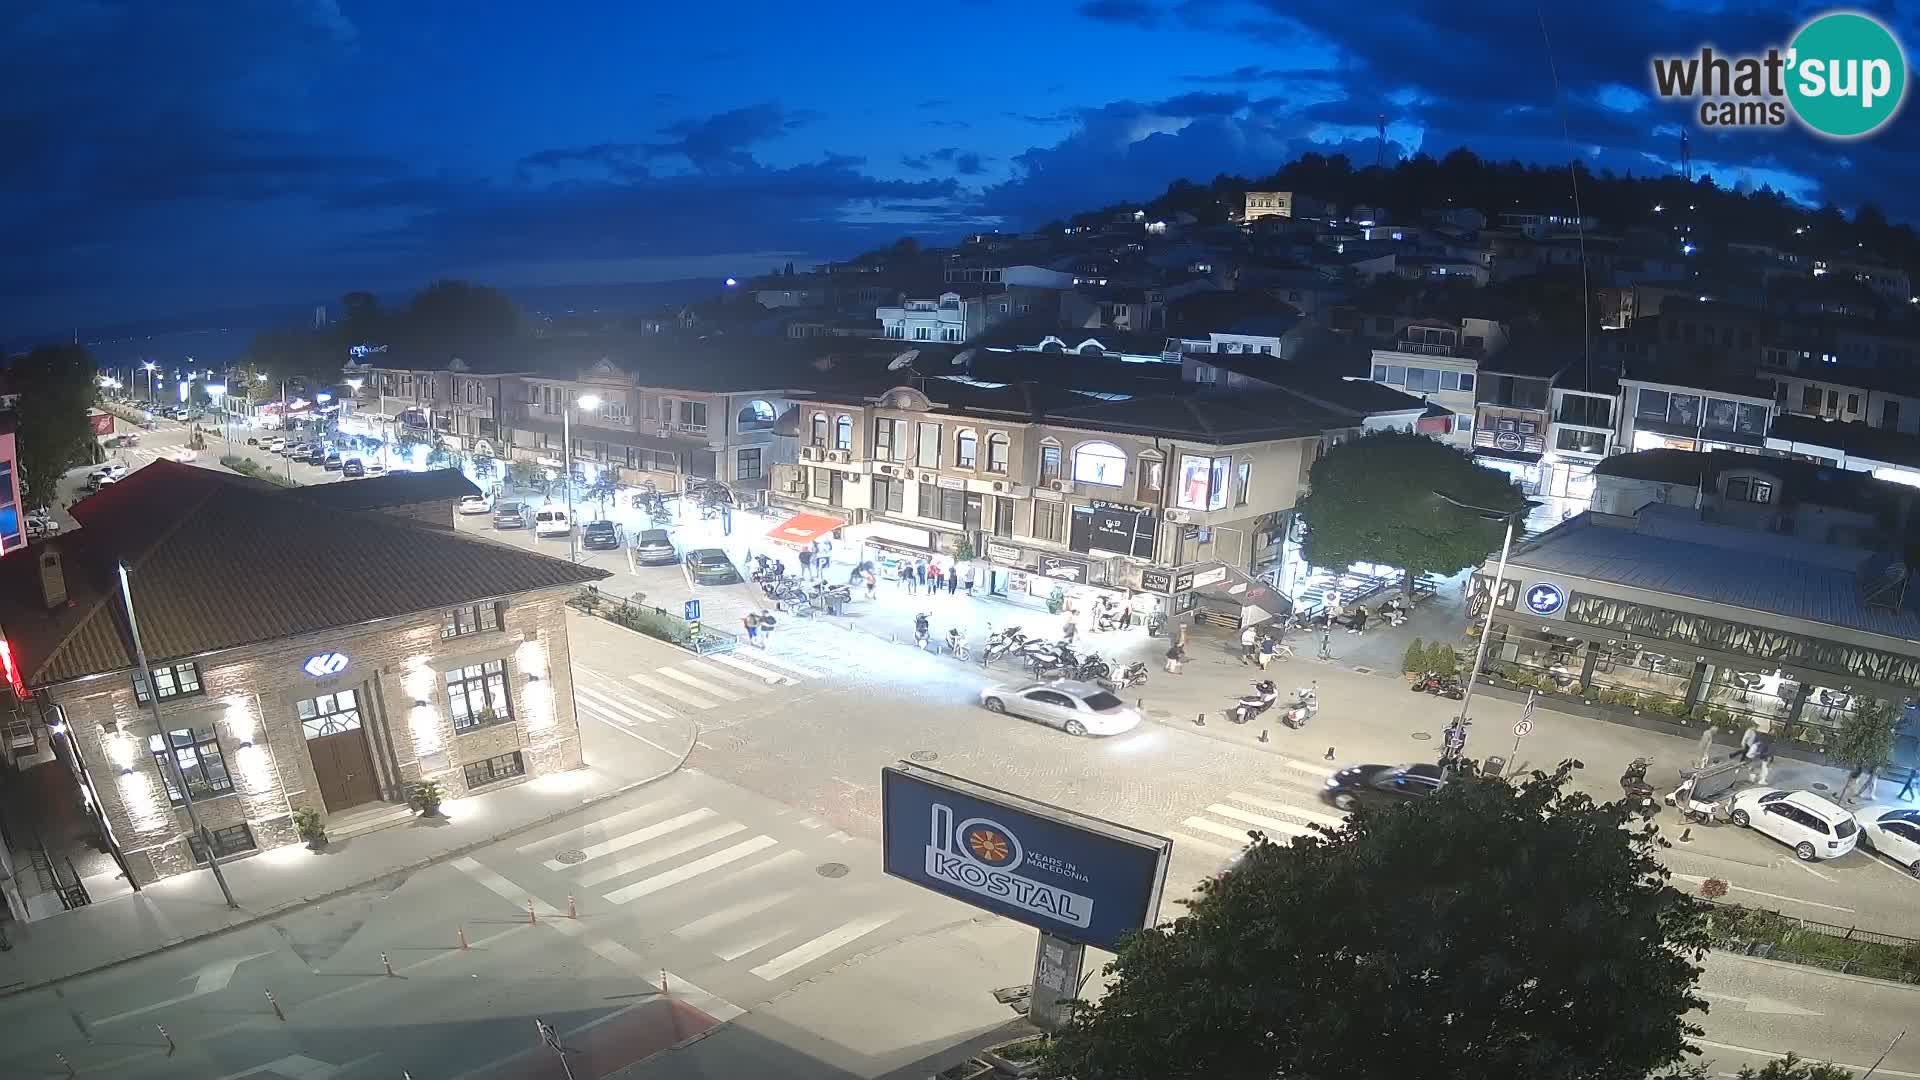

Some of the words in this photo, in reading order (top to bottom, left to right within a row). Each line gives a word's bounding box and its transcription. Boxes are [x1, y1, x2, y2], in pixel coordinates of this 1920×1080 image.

[1026, 857, 1090, 883] MACEDONIA
[1027, 850, 1063, 867] YEARS
[1065, 862, 1077, 871] IN
[935, 854, 1080, 922] KOSTAL
